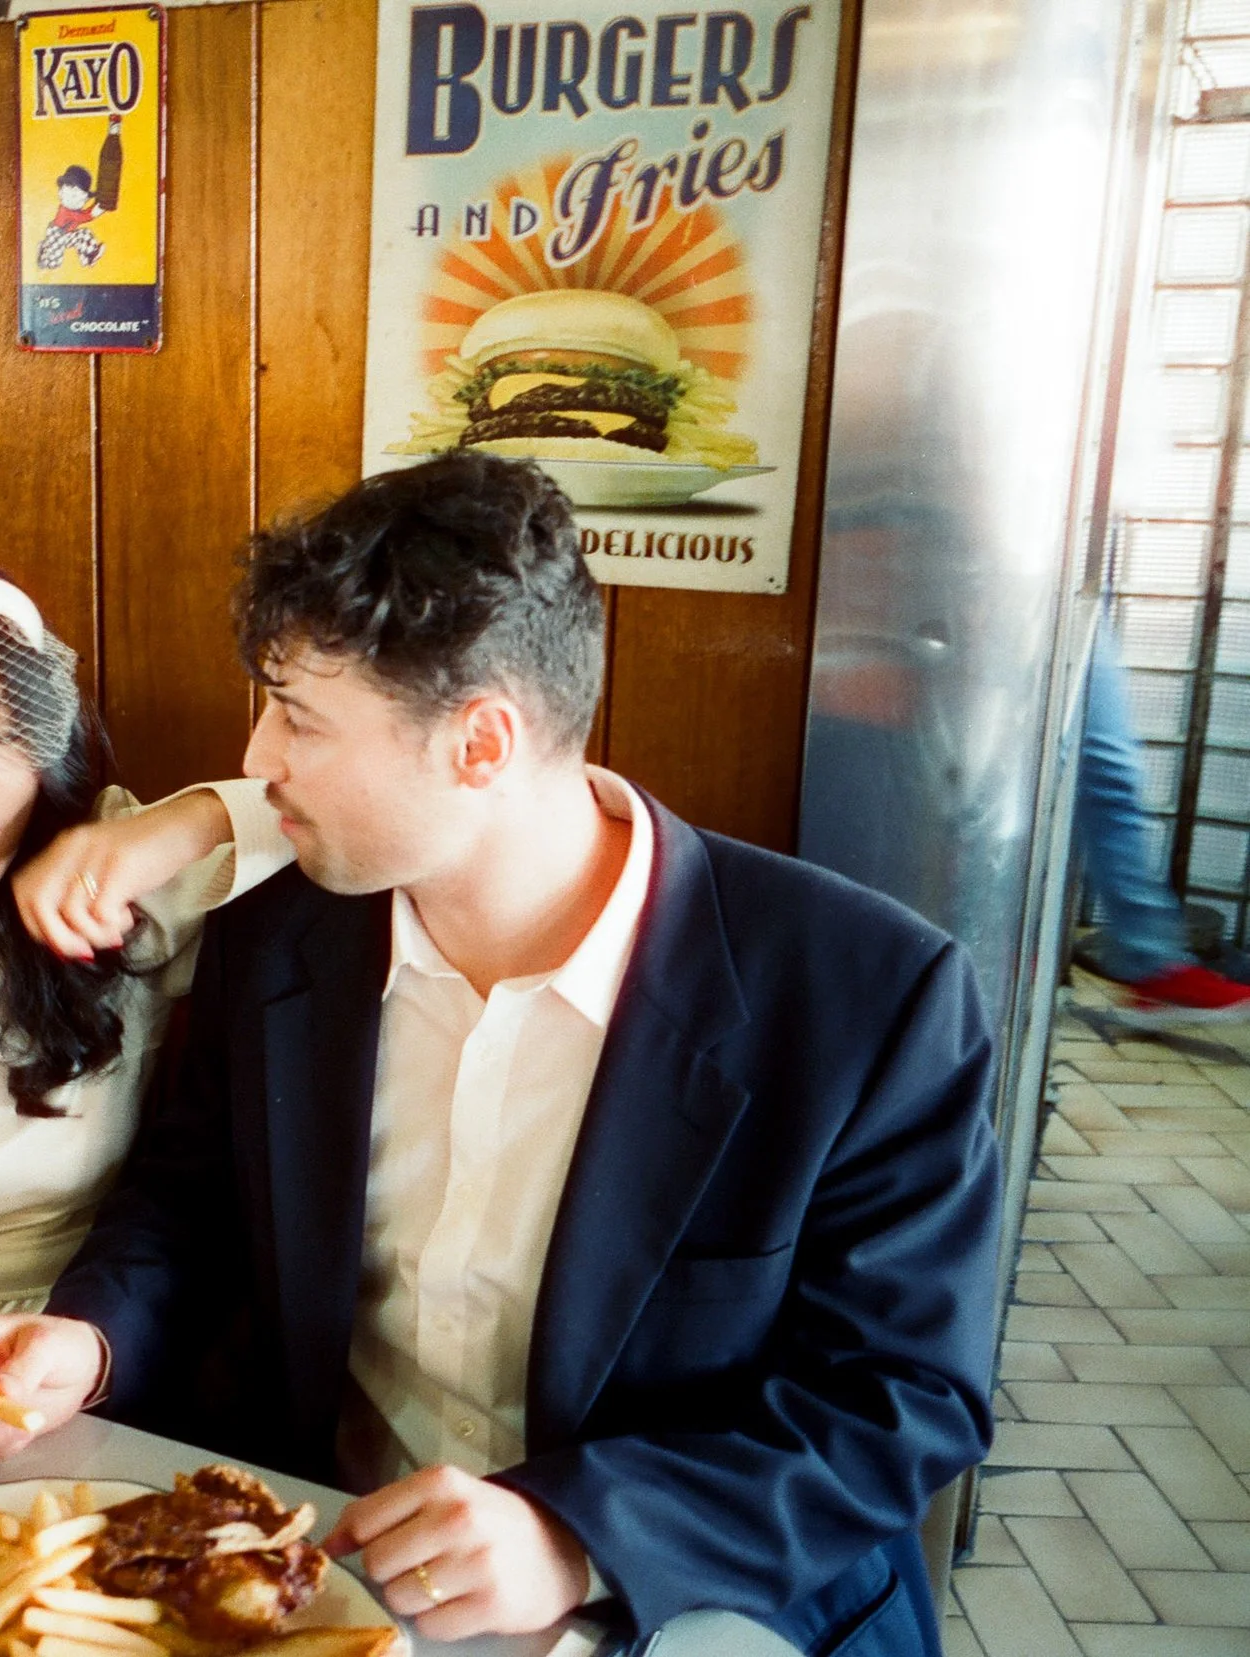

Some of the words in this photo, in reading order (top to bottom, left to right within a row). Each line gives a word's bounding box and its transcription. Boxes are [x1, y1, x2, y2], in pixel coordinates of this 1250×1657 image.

[57, 18, 116, 39] Demand
[32, 41, 141, 117] KAYO
[405, 2, 812, 158] BURGERS
[409, 202, 539, 239] AND
[549, 118, 786, 262] Fries
[579, 528, 755, 564] DELICIOUS
